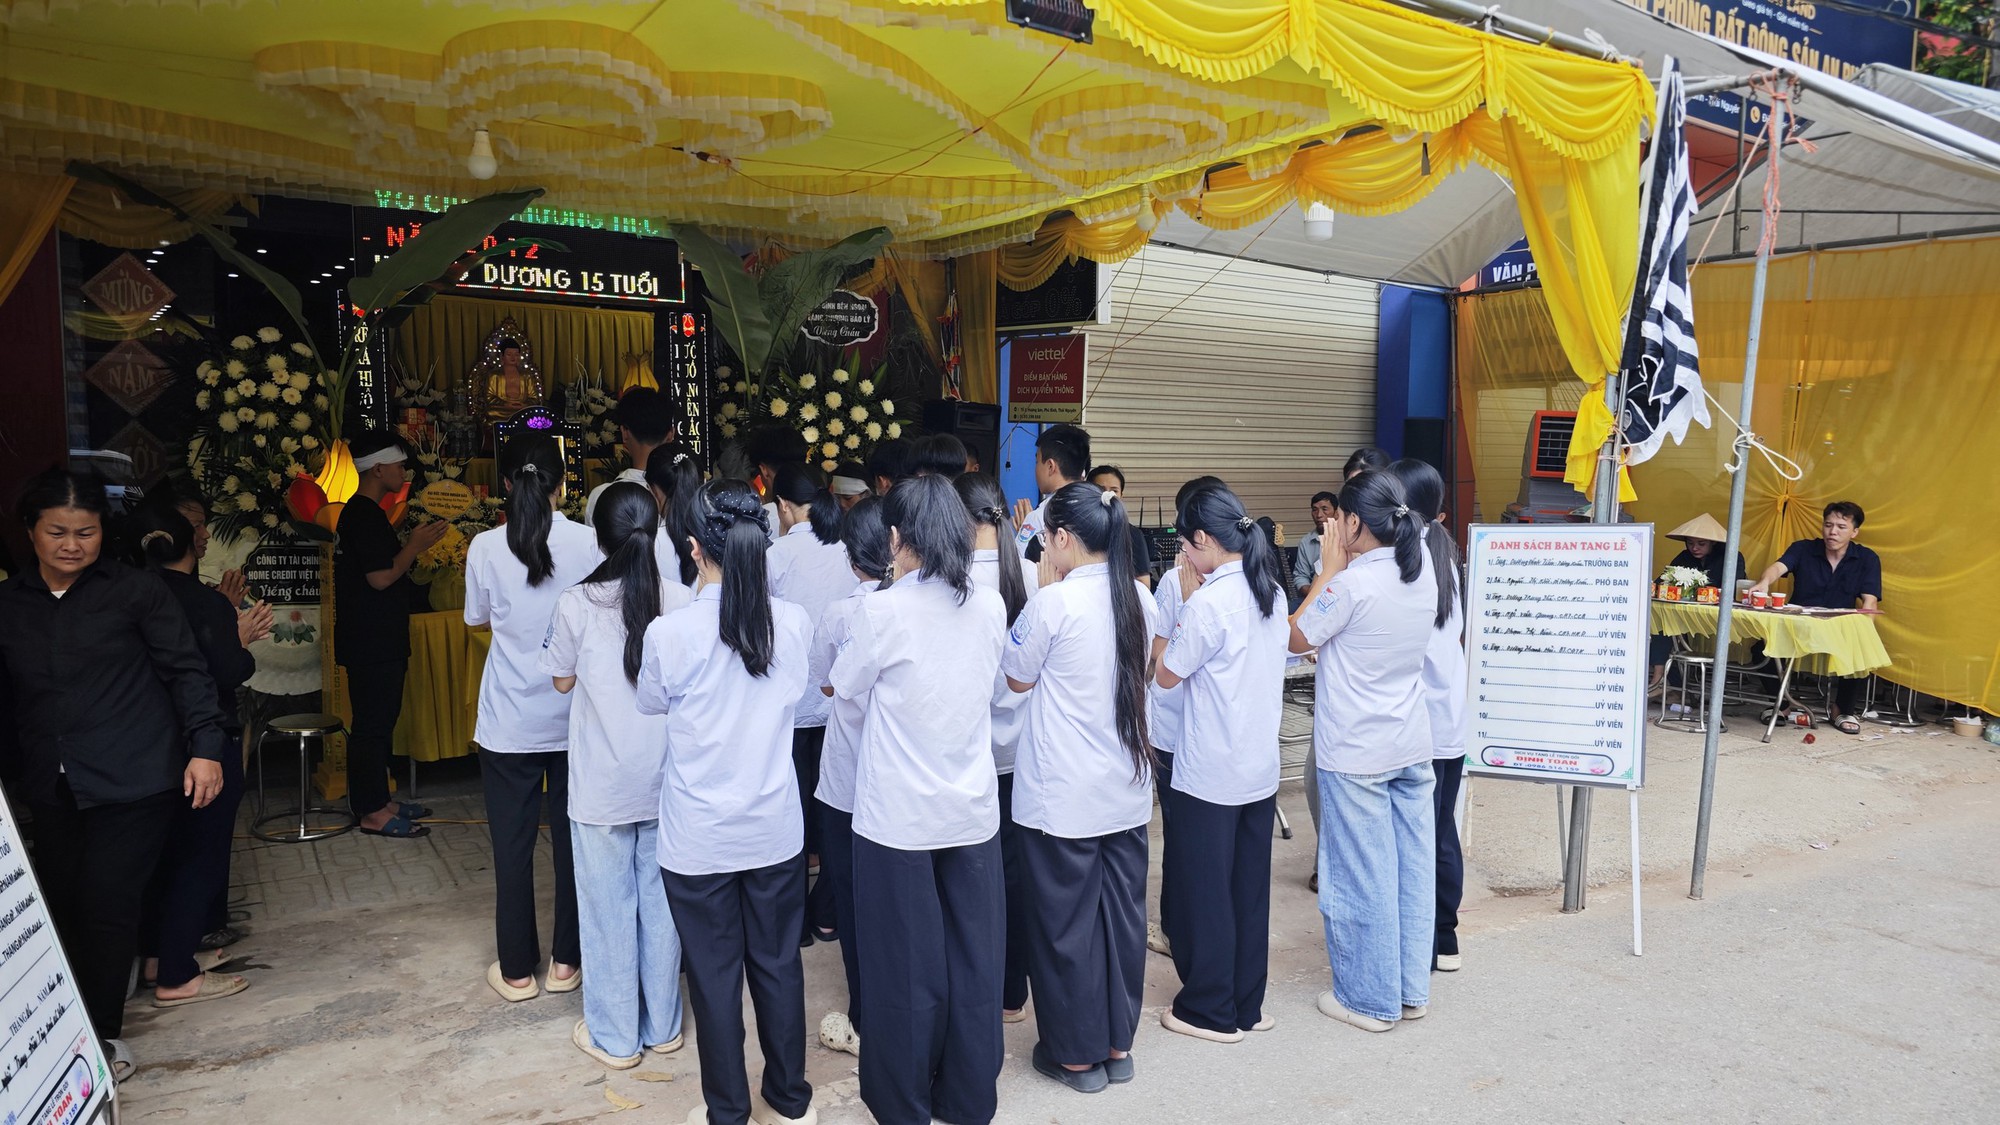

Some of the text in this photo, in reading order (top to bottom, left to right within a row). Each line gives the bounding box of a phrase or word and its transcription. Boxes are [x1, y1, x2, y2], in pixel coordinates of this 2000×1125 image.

[1493, 262, 1523, 283] VĂN
[581, 271, 604, 292] 15
[1028, 348, 1065, 361] viettel
[1490, 537, 1627, 551] DANH SÁCH BAN TANG LỄ
[256, 554, 320, 565] CÔNG TY TÀI CHÍN
[1584, 557, 1612, 567] TRƯỞNG
[248, 570, 270, 580] HOME
[271, 570, 297, 580] CREDIT
[298, 568, 314, 582] VIỆT
[1595, 576, 1611, 586] PHÓ
[1612, 595, 1628, 603] VIÊN
[1610, 612, 1627, 621] VIÊN
[1609, 630, 1626, 639] VIÊN
[1608, 648, 1625, 657] VIÊN
[1608, 666, 1625, 675] VIÊN
[1607, 684, 1624, 692] VIÊN
[1606, 702, 1623, 710] VIÊN
[1606, 720, 1623, 729] VIÊN
[1605, 740, 1622, 749] VIÊN
[68, 1103, 79, 1119] 159
